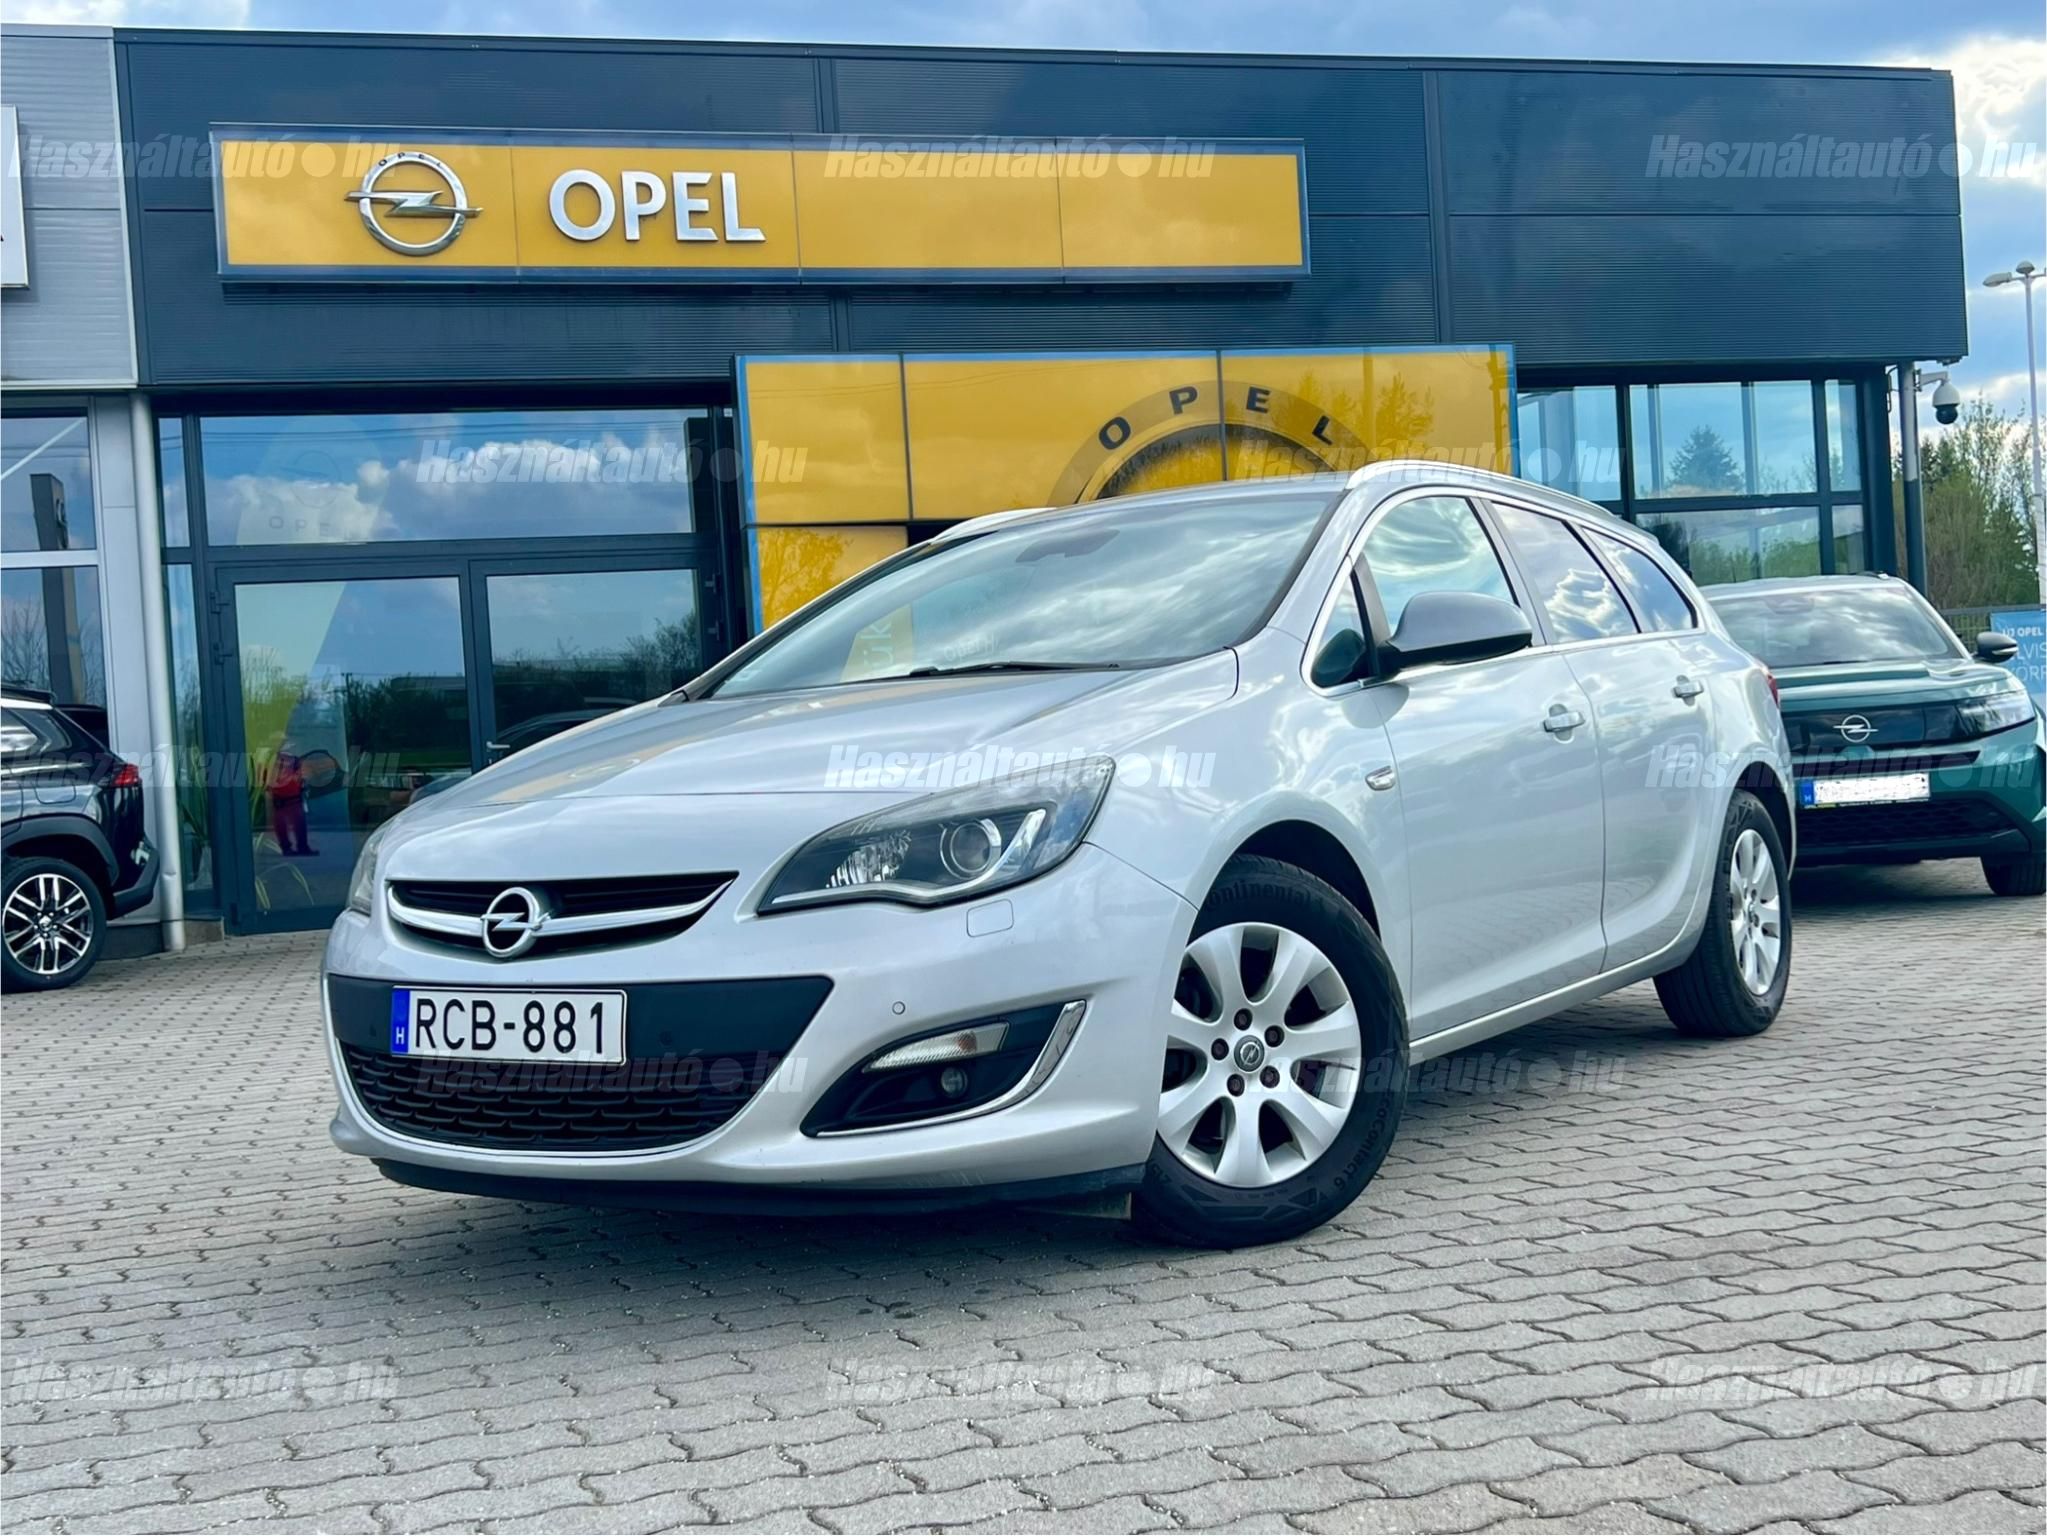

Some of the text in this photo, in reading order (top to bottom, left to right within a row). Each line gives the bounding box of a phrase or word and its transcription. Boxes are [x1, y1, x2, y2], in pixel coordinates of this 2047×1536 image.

[549, 169, 767, 241] OPEL
[1098, 386, 1334, 450] OPEL
[2017, 626, 2045, 638] OPEL
[396, 1027, 405, 1045] H
[415, 998, 604, 1054] RCB-881
